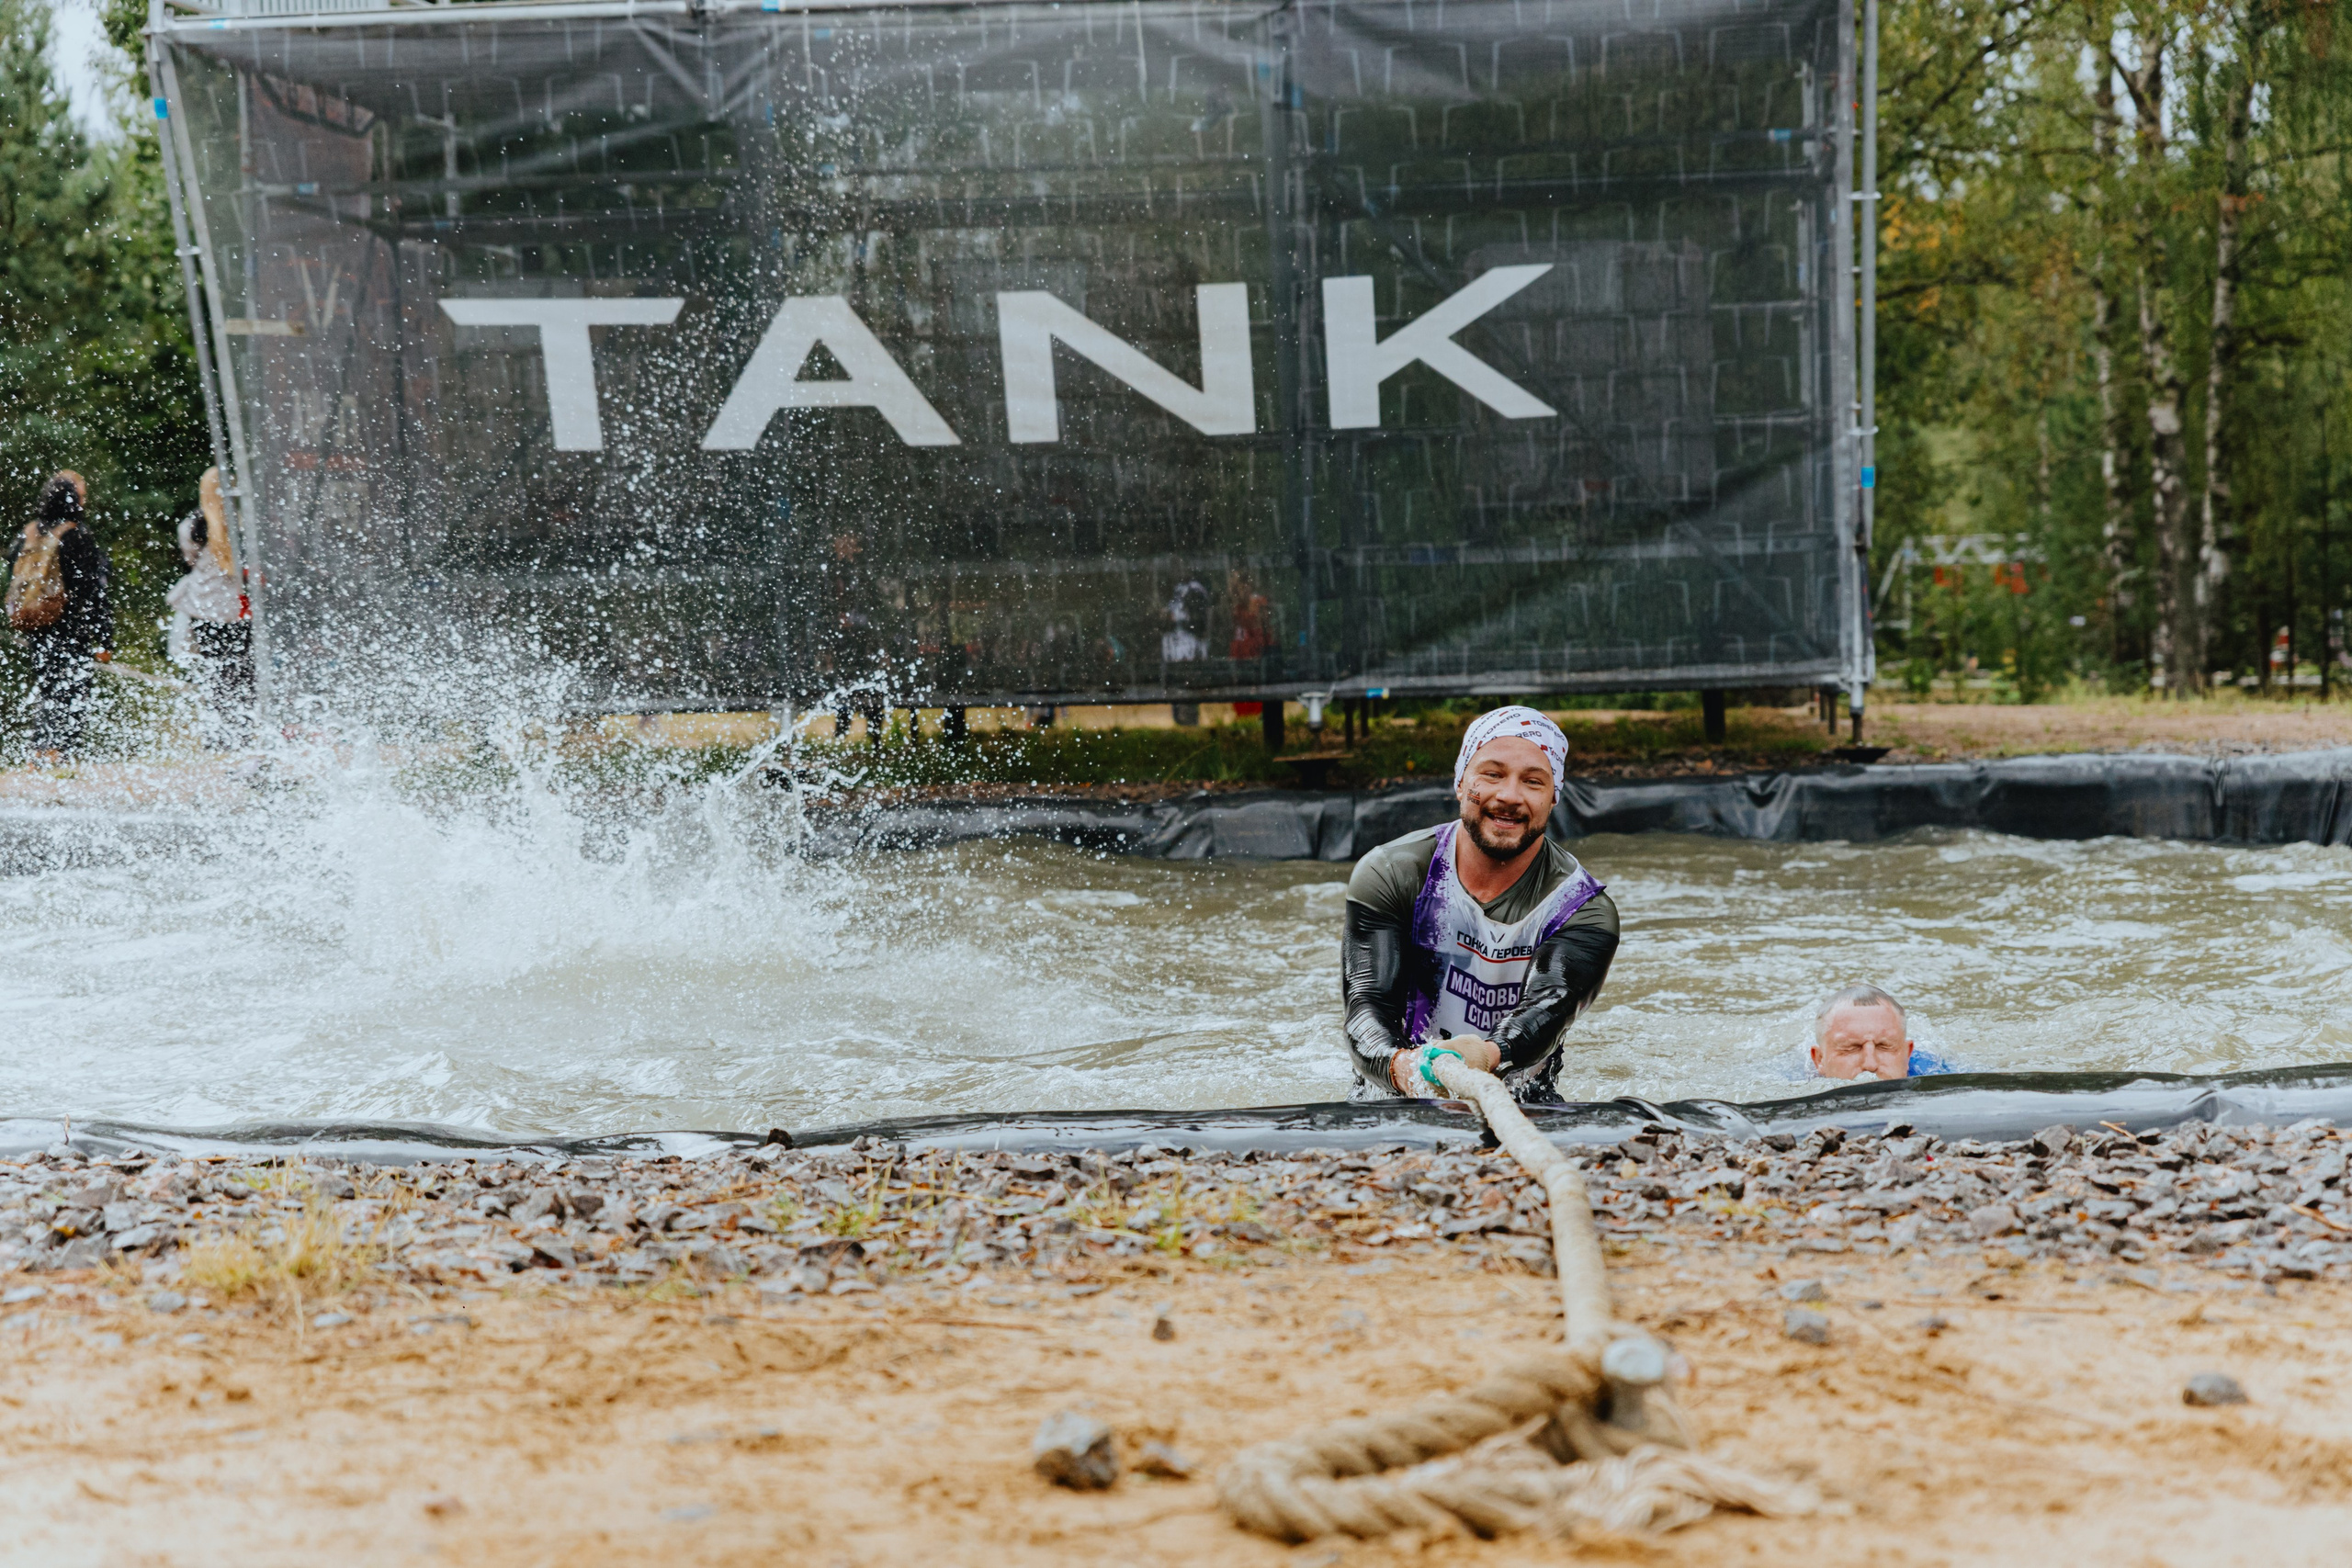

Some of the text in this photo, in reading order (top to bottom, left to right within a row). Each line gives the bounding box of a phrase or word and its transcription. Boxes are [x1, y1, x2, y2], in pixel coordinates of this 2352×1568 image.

[439, 263, 1558, 452] TANK
[1482, 713, 1521, 739] TORERO
[1456, 931, 1532, 959] ГОНКА ГЕРОЕВ
